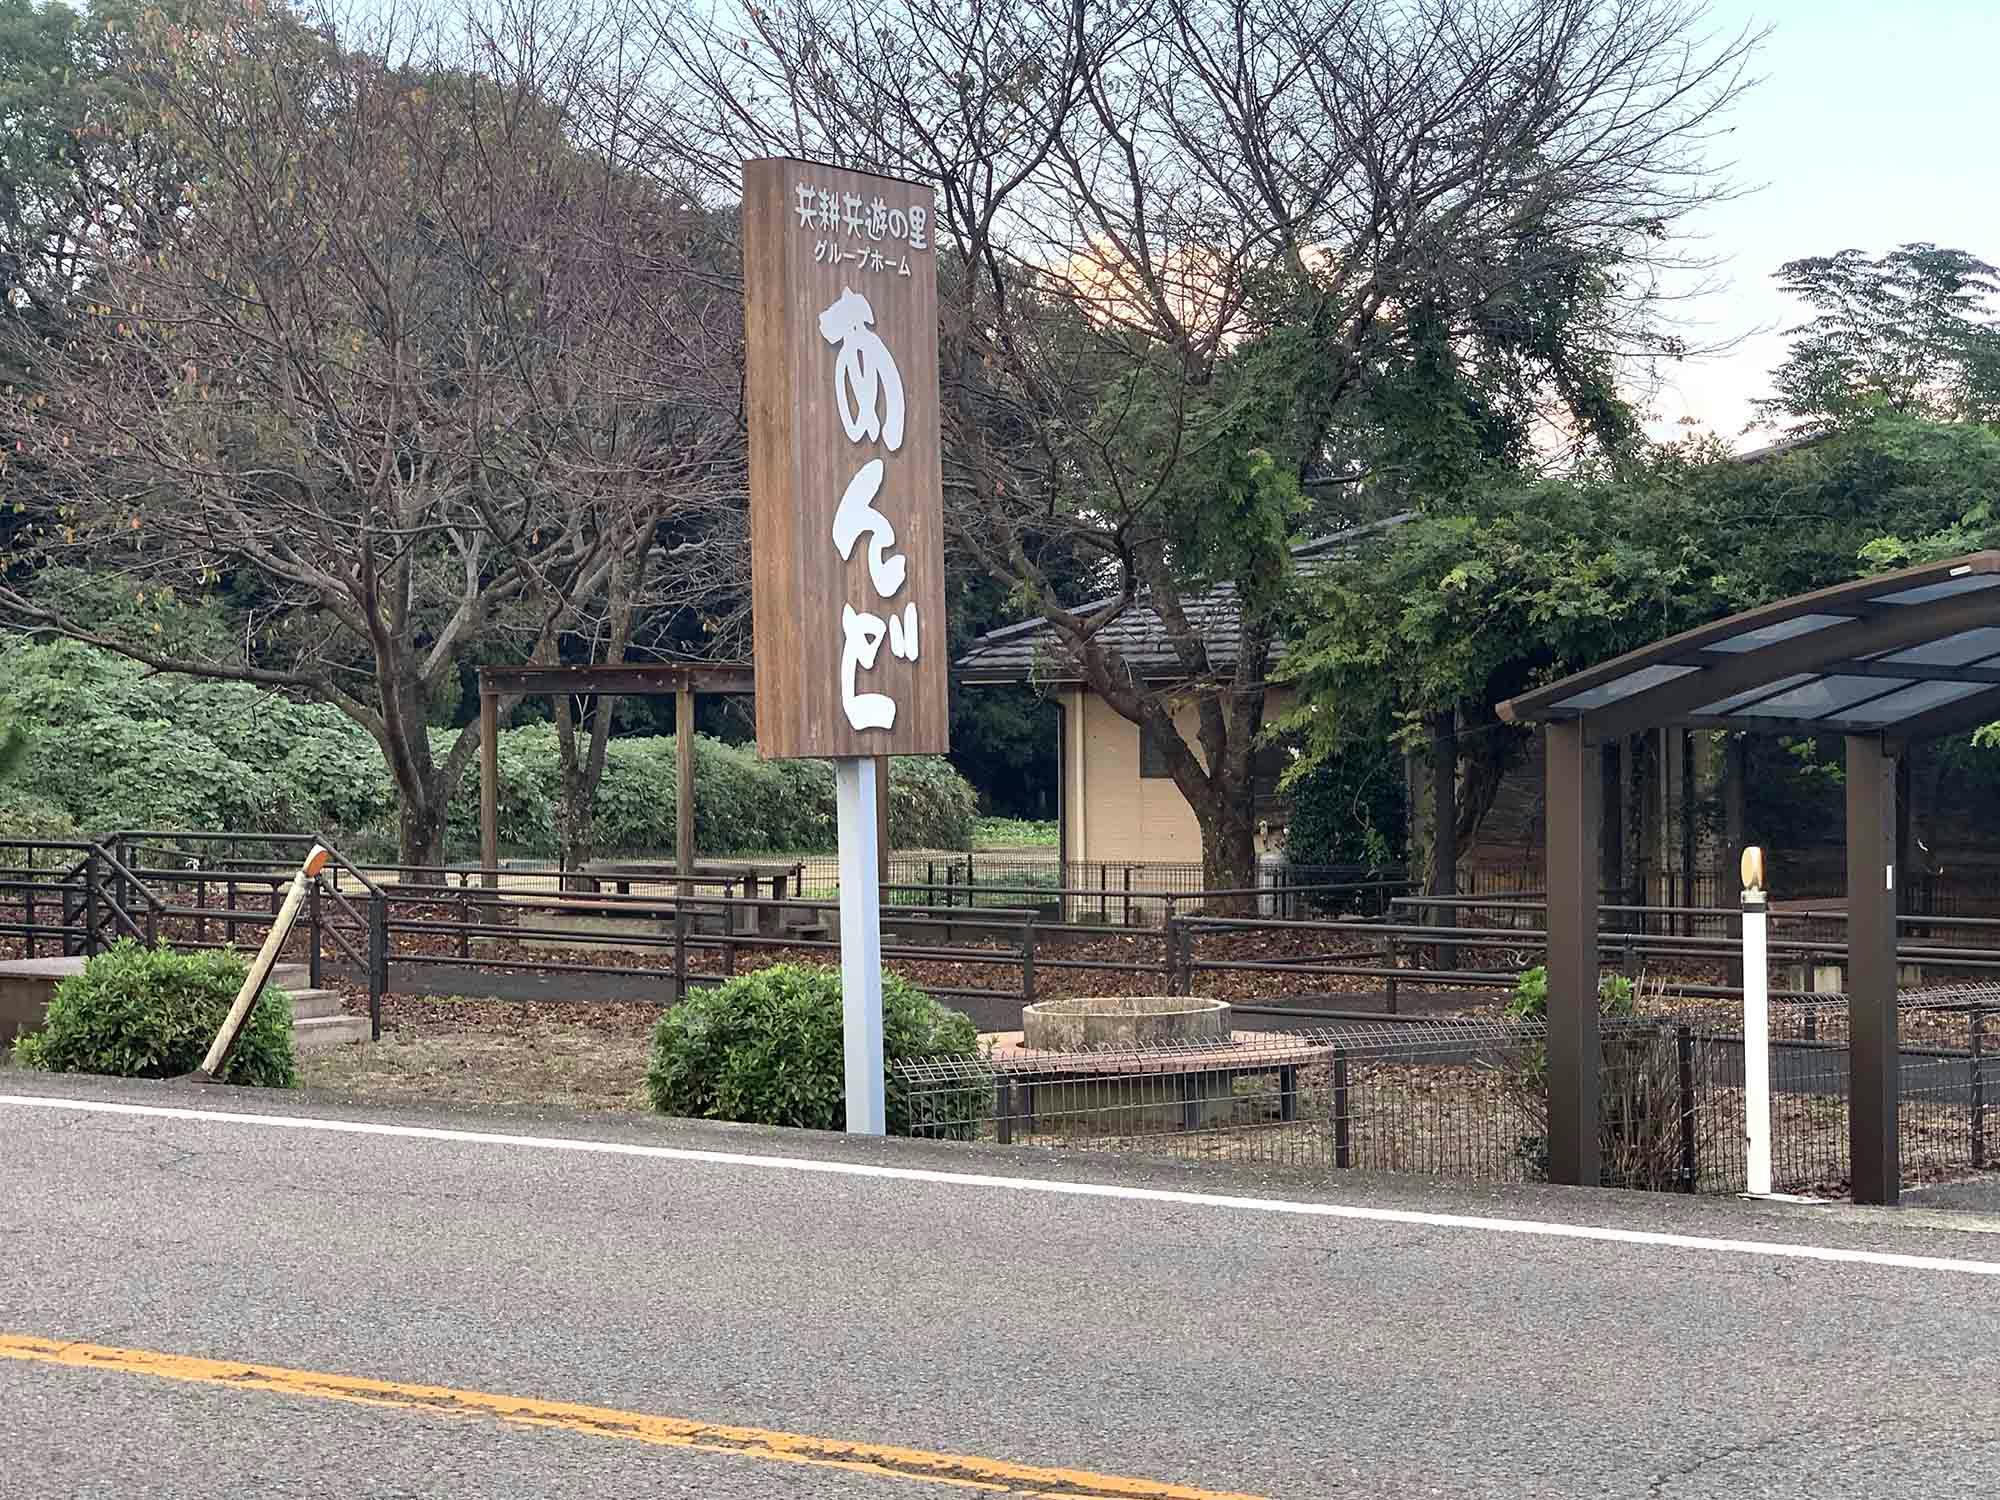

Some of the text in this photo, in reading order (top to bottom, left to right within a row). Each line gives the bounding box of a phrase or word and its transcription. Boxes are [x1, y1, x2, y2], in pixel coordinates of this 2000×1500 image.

[814, 240, 912, 277] グループホーム
